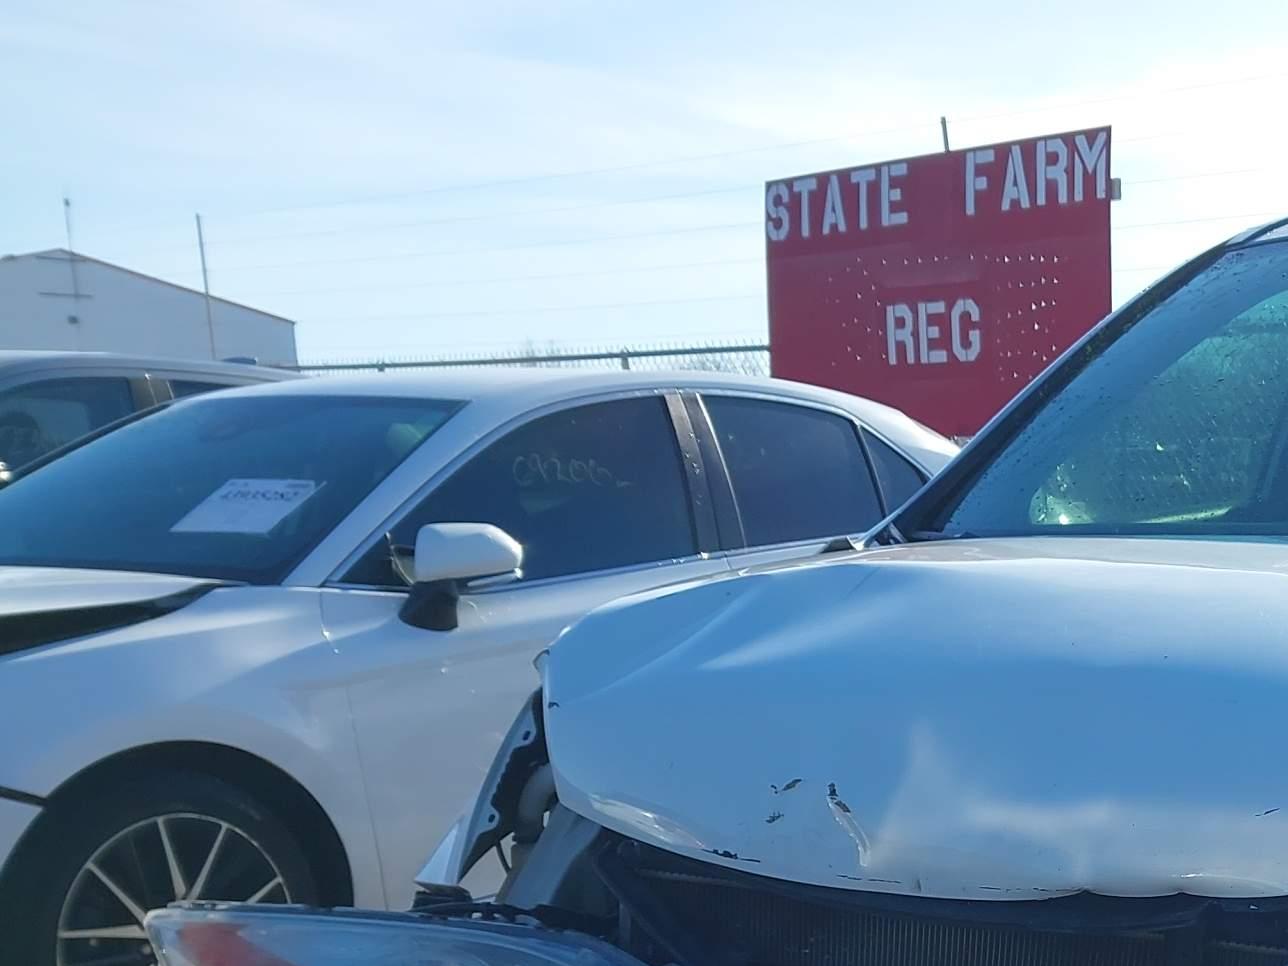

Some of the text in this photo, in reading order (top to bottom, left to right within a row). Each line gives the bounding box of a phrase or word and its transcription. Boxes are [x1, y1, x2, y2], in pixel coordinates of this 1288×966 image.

[766, 131, 1107, 241] STATE FARM
[885, 298, 981, 365] REG
